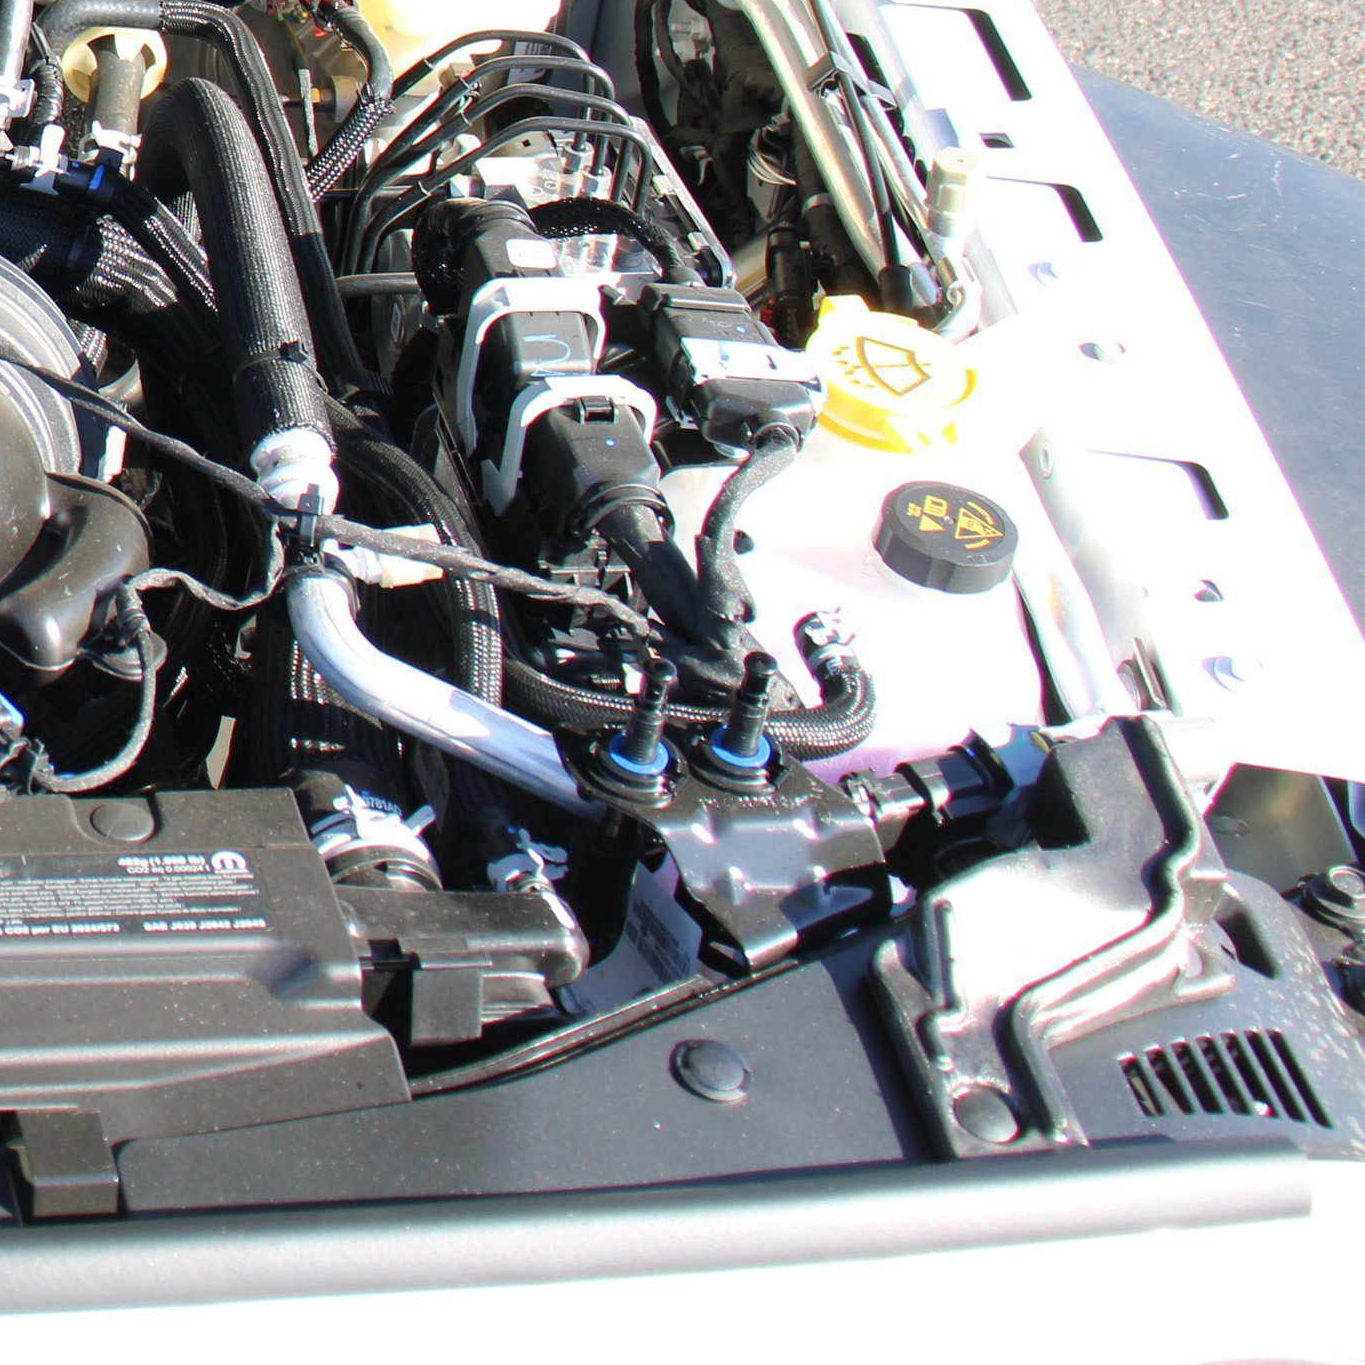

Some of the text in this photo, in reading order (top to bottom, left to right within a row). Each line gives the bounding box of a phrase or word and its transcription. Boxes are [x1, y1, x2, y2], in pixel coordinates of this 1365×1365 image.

[126, 866, 150, 874] CO2
[165, 864, 204, 873] 0.00024
[4, 925, 30, 936] CO2
[30, 926, 51, 937] per
[51, 923, 70, 934] EU
